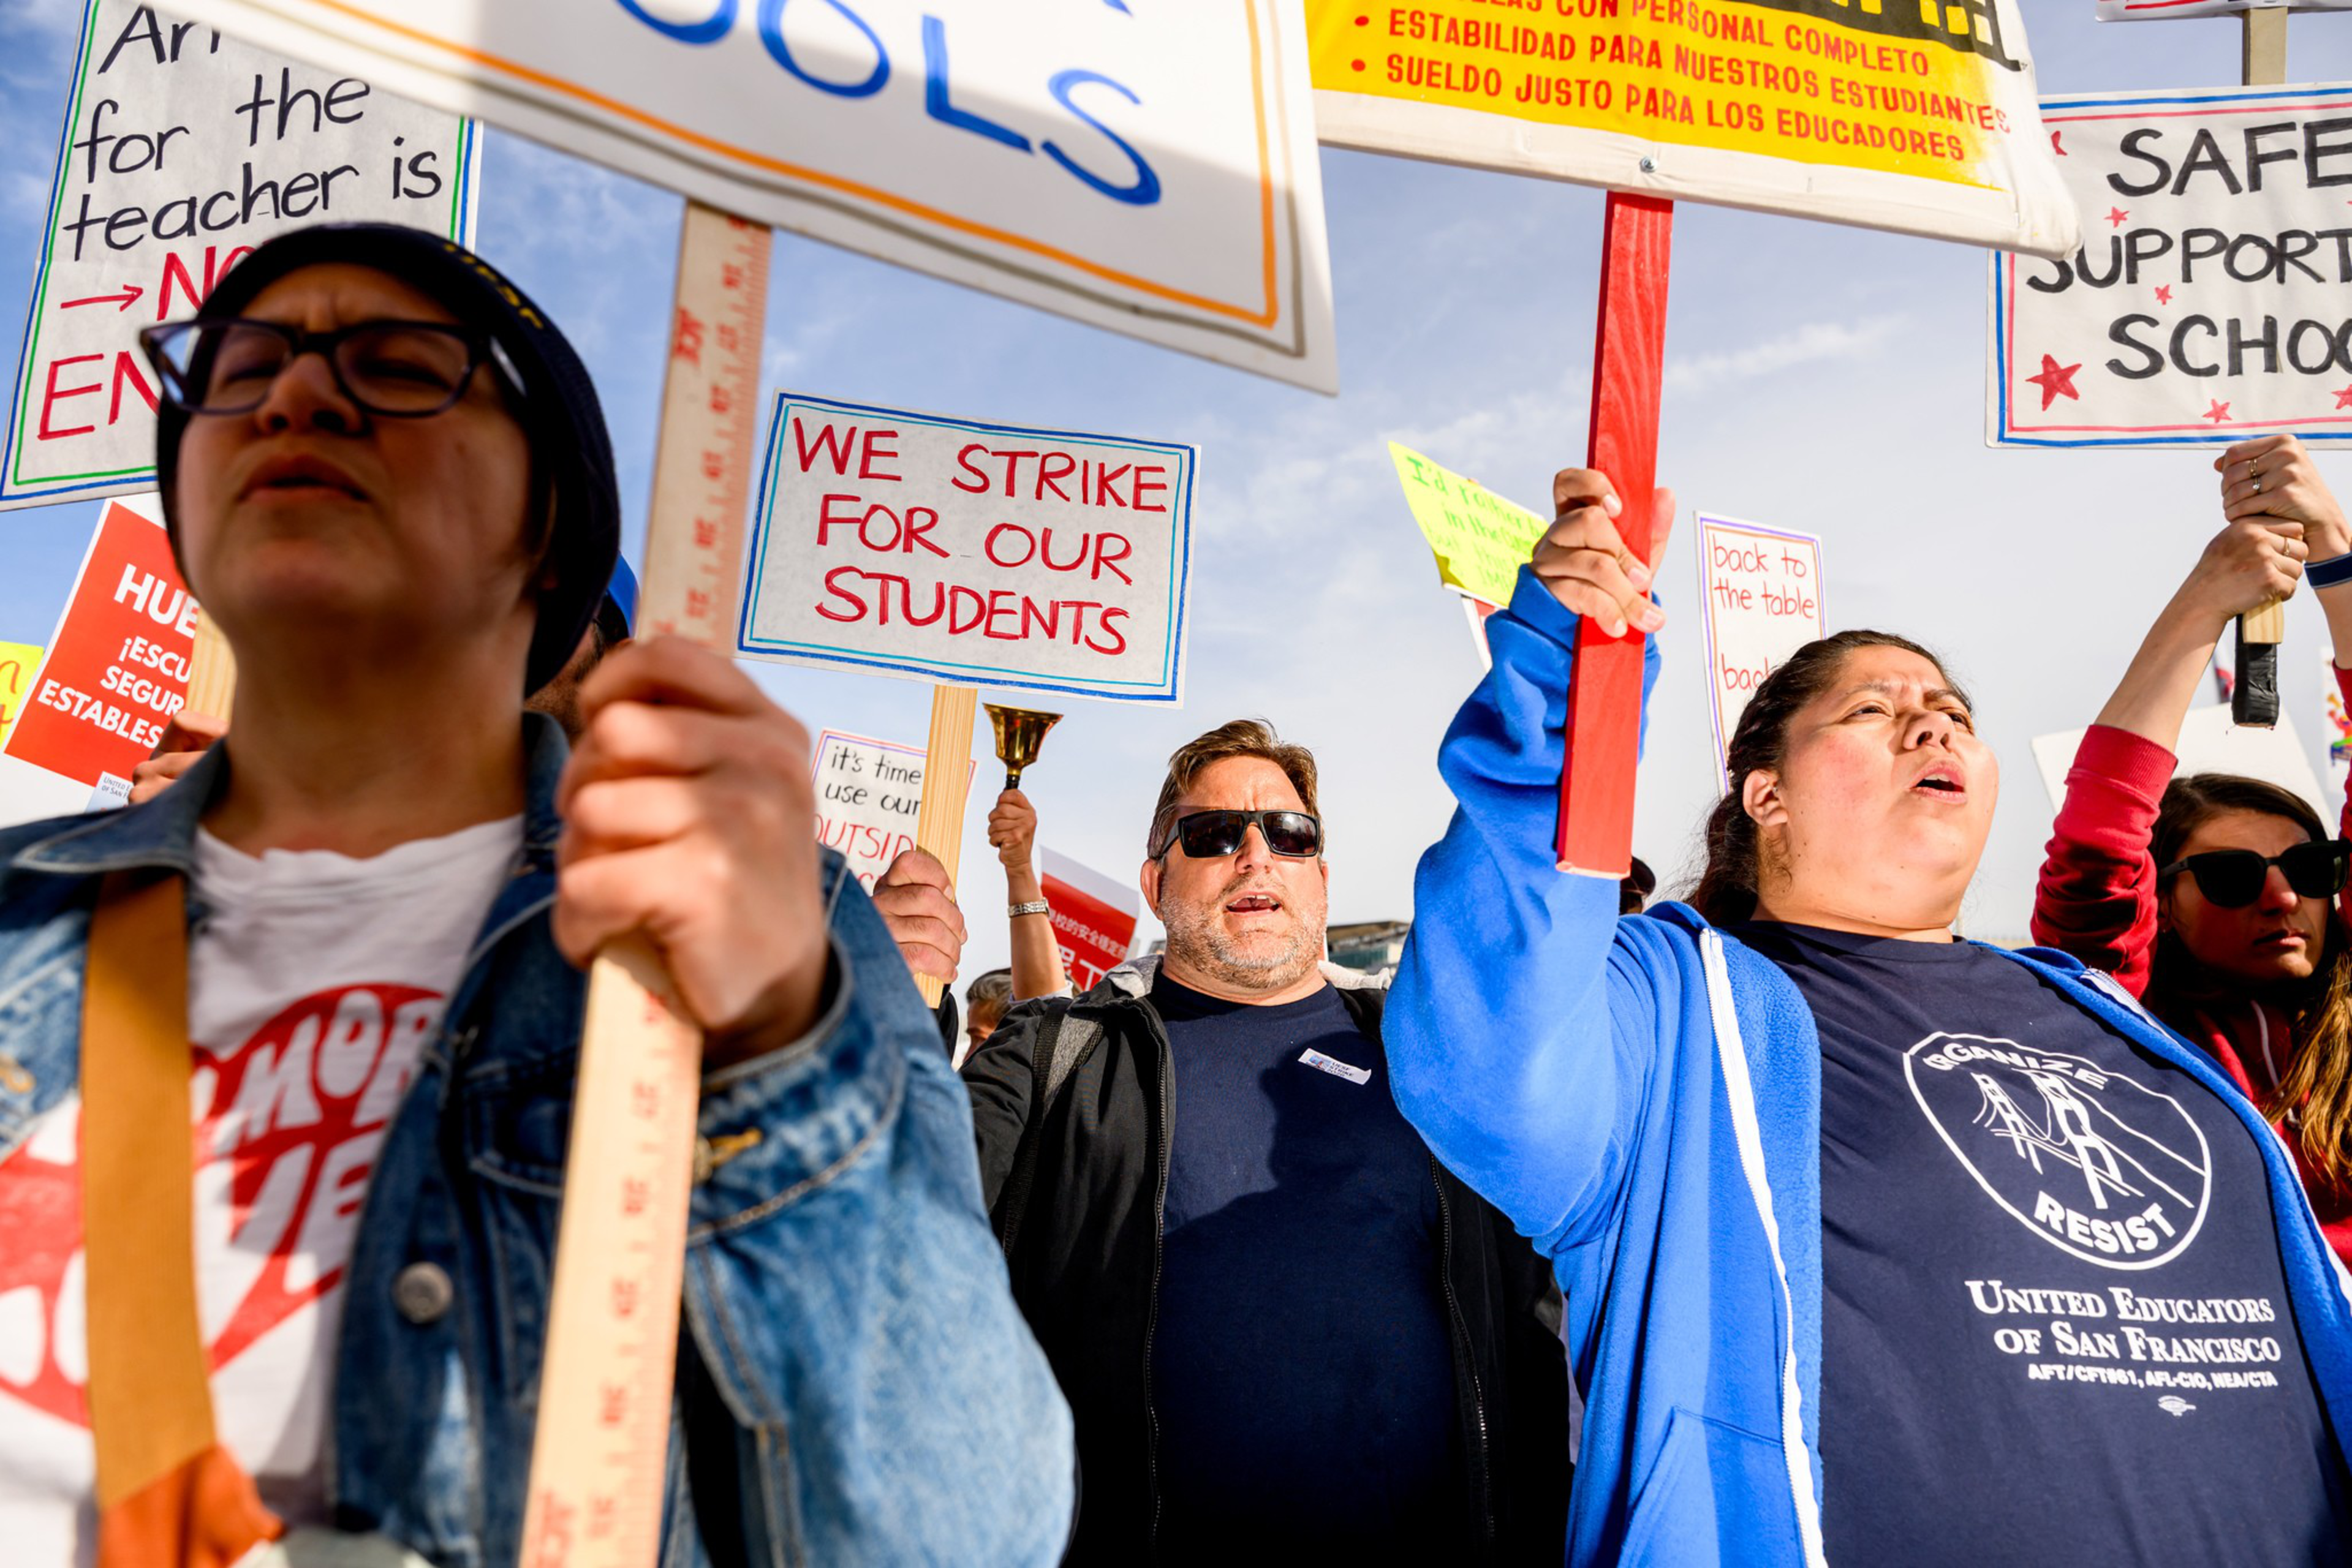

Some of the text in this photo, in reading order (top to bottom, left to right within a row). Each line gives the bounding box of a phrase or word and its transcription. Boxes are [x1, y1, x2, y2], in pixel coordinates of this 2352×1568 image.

[1389, 9, 2011, 134] ESTABILIDAD PARA NUESTROS ESTUDIANTES
[1632, 0, 1774, 47] PERSONAL
[1785, 24, 1929, 77] COMPLETO
[73, 67, 370, 183] for the
[1387, 53, 1964, 161] SUELDO JUSTO PARA LOS EDUCADORES
[2106, 118, 2352, 197] SAFE
[62, 137, 442, 262] teacher is
[793, 417, 1167, 512] WE STRIKE
[817, 494, 1132, 585] FOR OUR
[1712, 533, 1807, 578] back to
[815, 566, 1130, 655] STUDENTS
[1714, 578, 1815, 619] the table
[825, 783, 922, 816] use our
[831, 745, 921, 785] it's time
[2033, 1190, 2177, 1254] RESIST
[1964, 1280, 2276, 1323] UNITED EDUCATORS
[1993, 1321, 2282, 1363] OF SAN FRANCISCO
